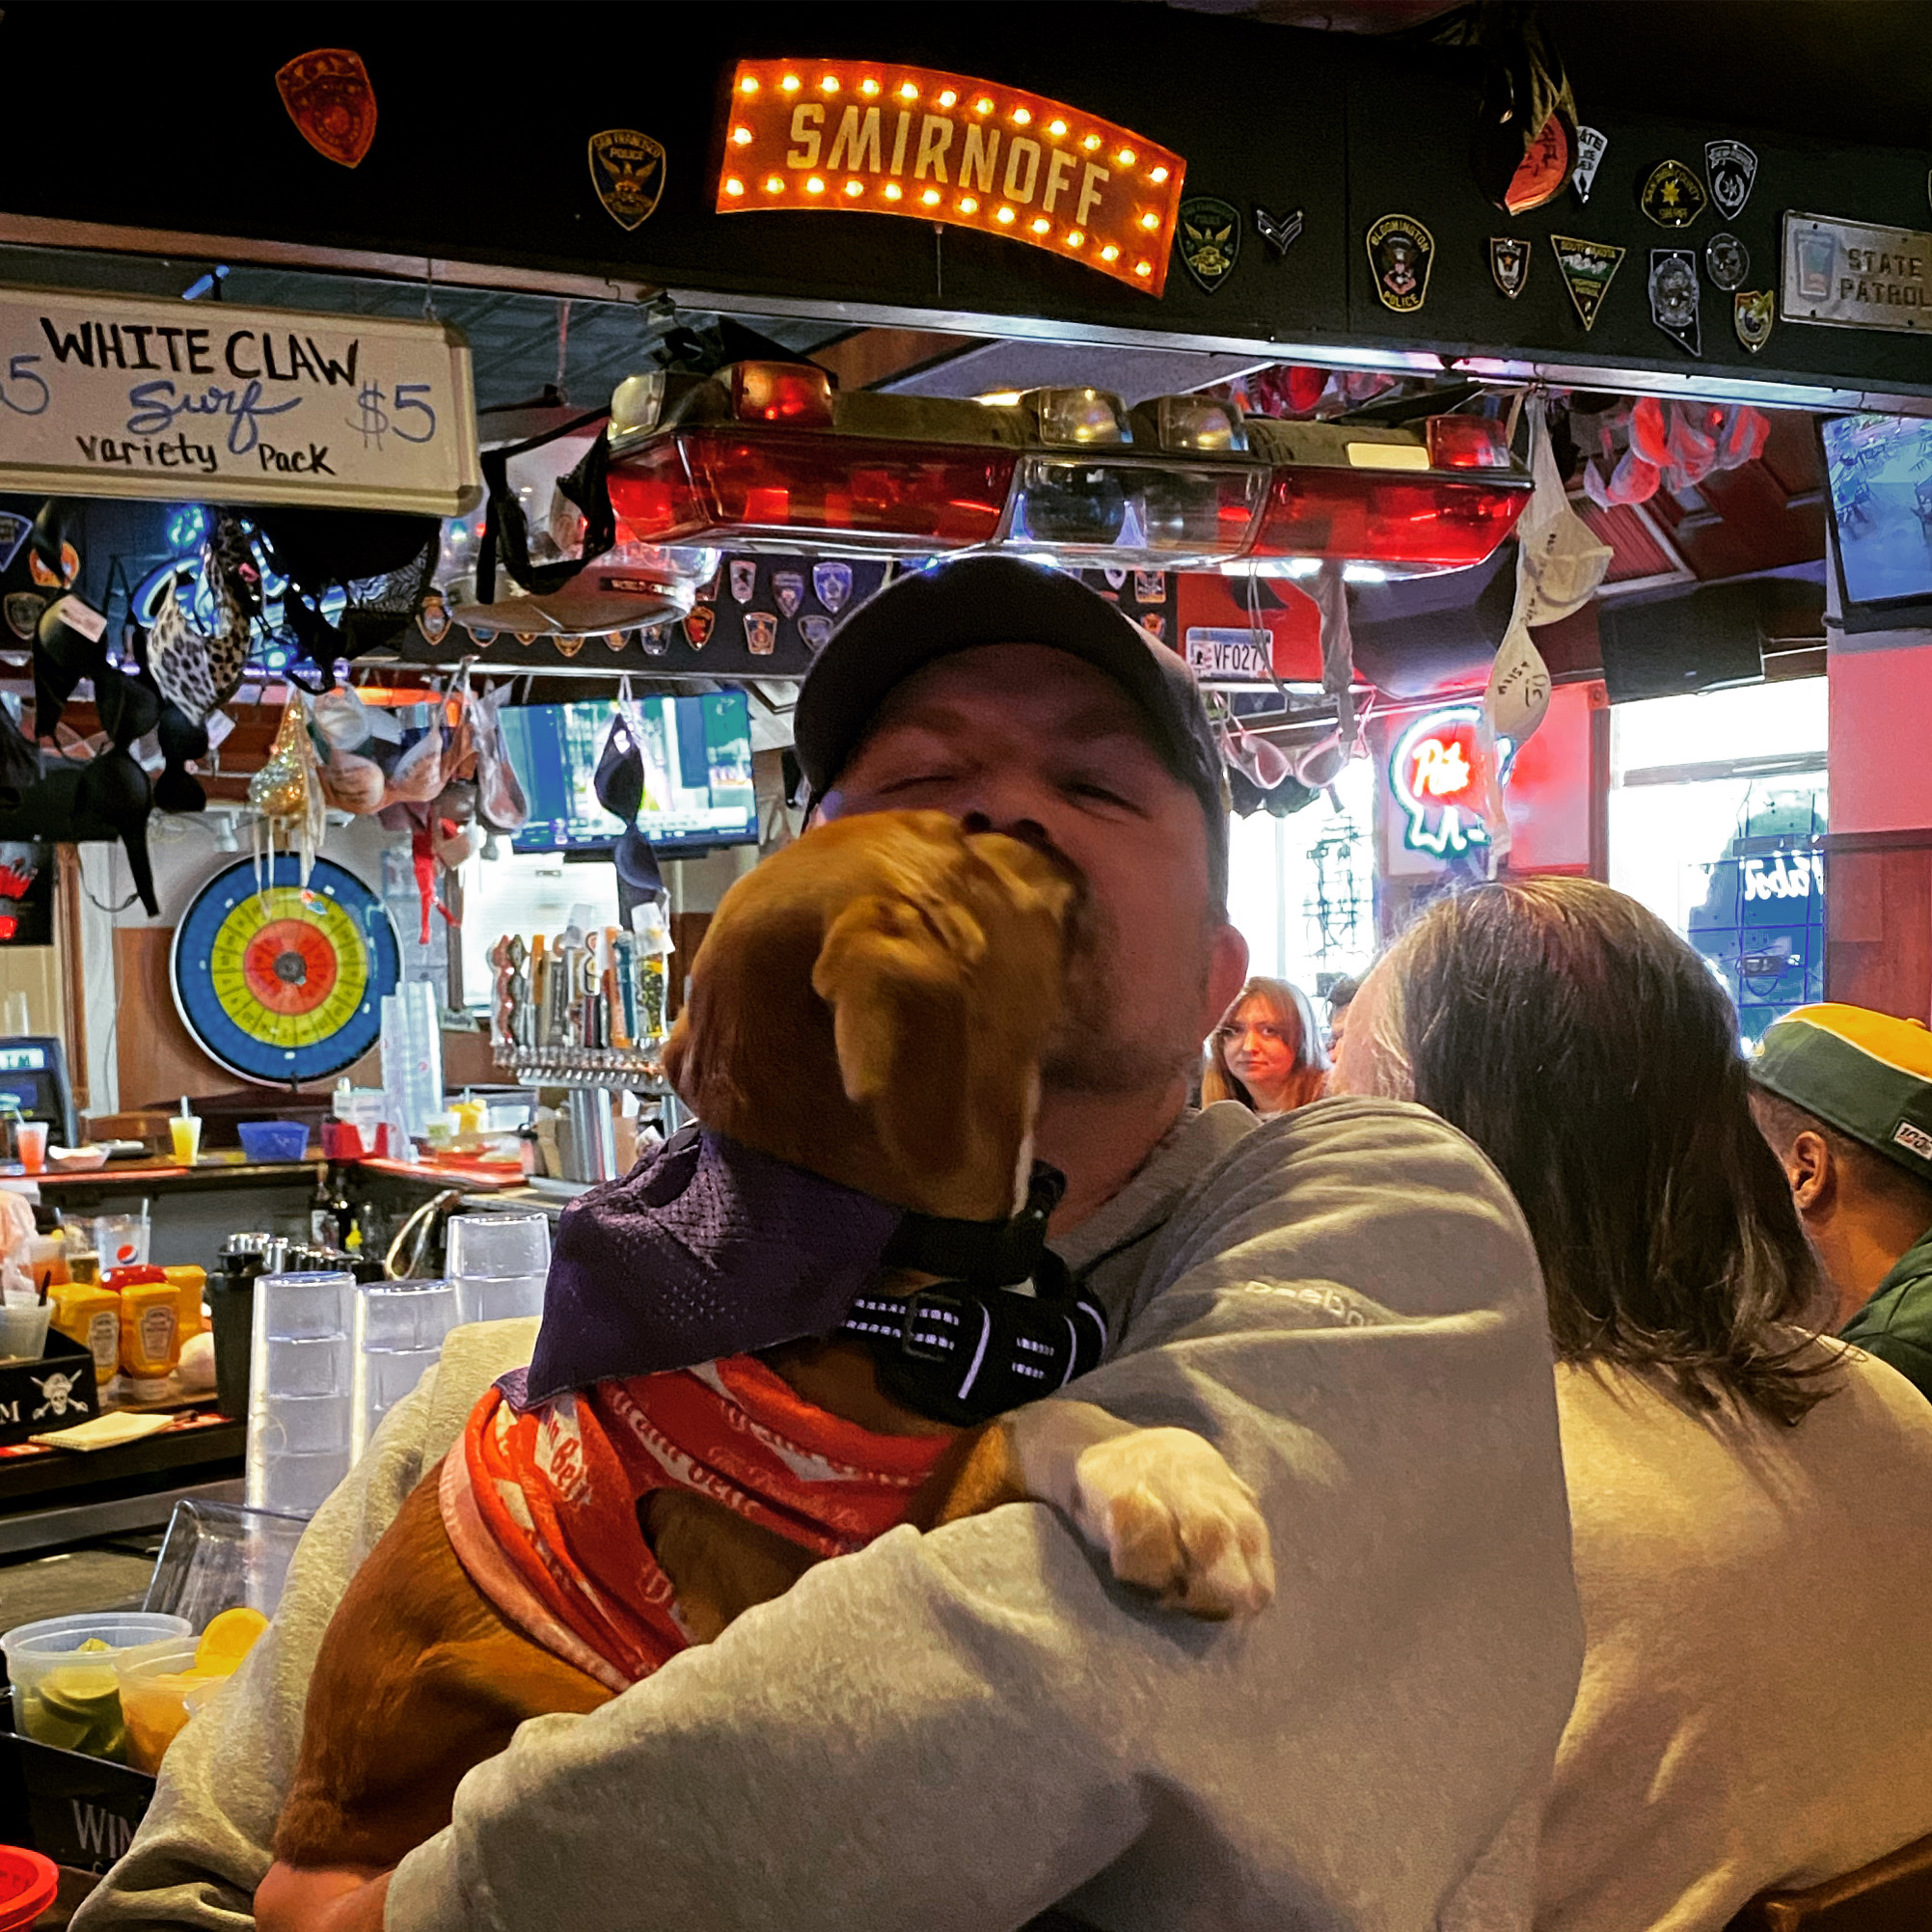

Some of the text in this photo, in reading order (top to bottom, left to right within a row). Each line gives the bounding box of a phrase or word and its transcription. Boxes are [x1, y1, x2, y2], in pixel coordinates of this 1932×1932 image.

[786, 102, 1110, 227] SMIRNOFF
[1840, 277, 1932, 308] PATROL
[1847, 247, 1923, 278] STATE
[1383, 290, 1420, 308] POLICE
[40, 316, 360, 387] WHITE CLAW
[126, 379, 303, 454] Surf
[344, 379, 437, 451] $5
